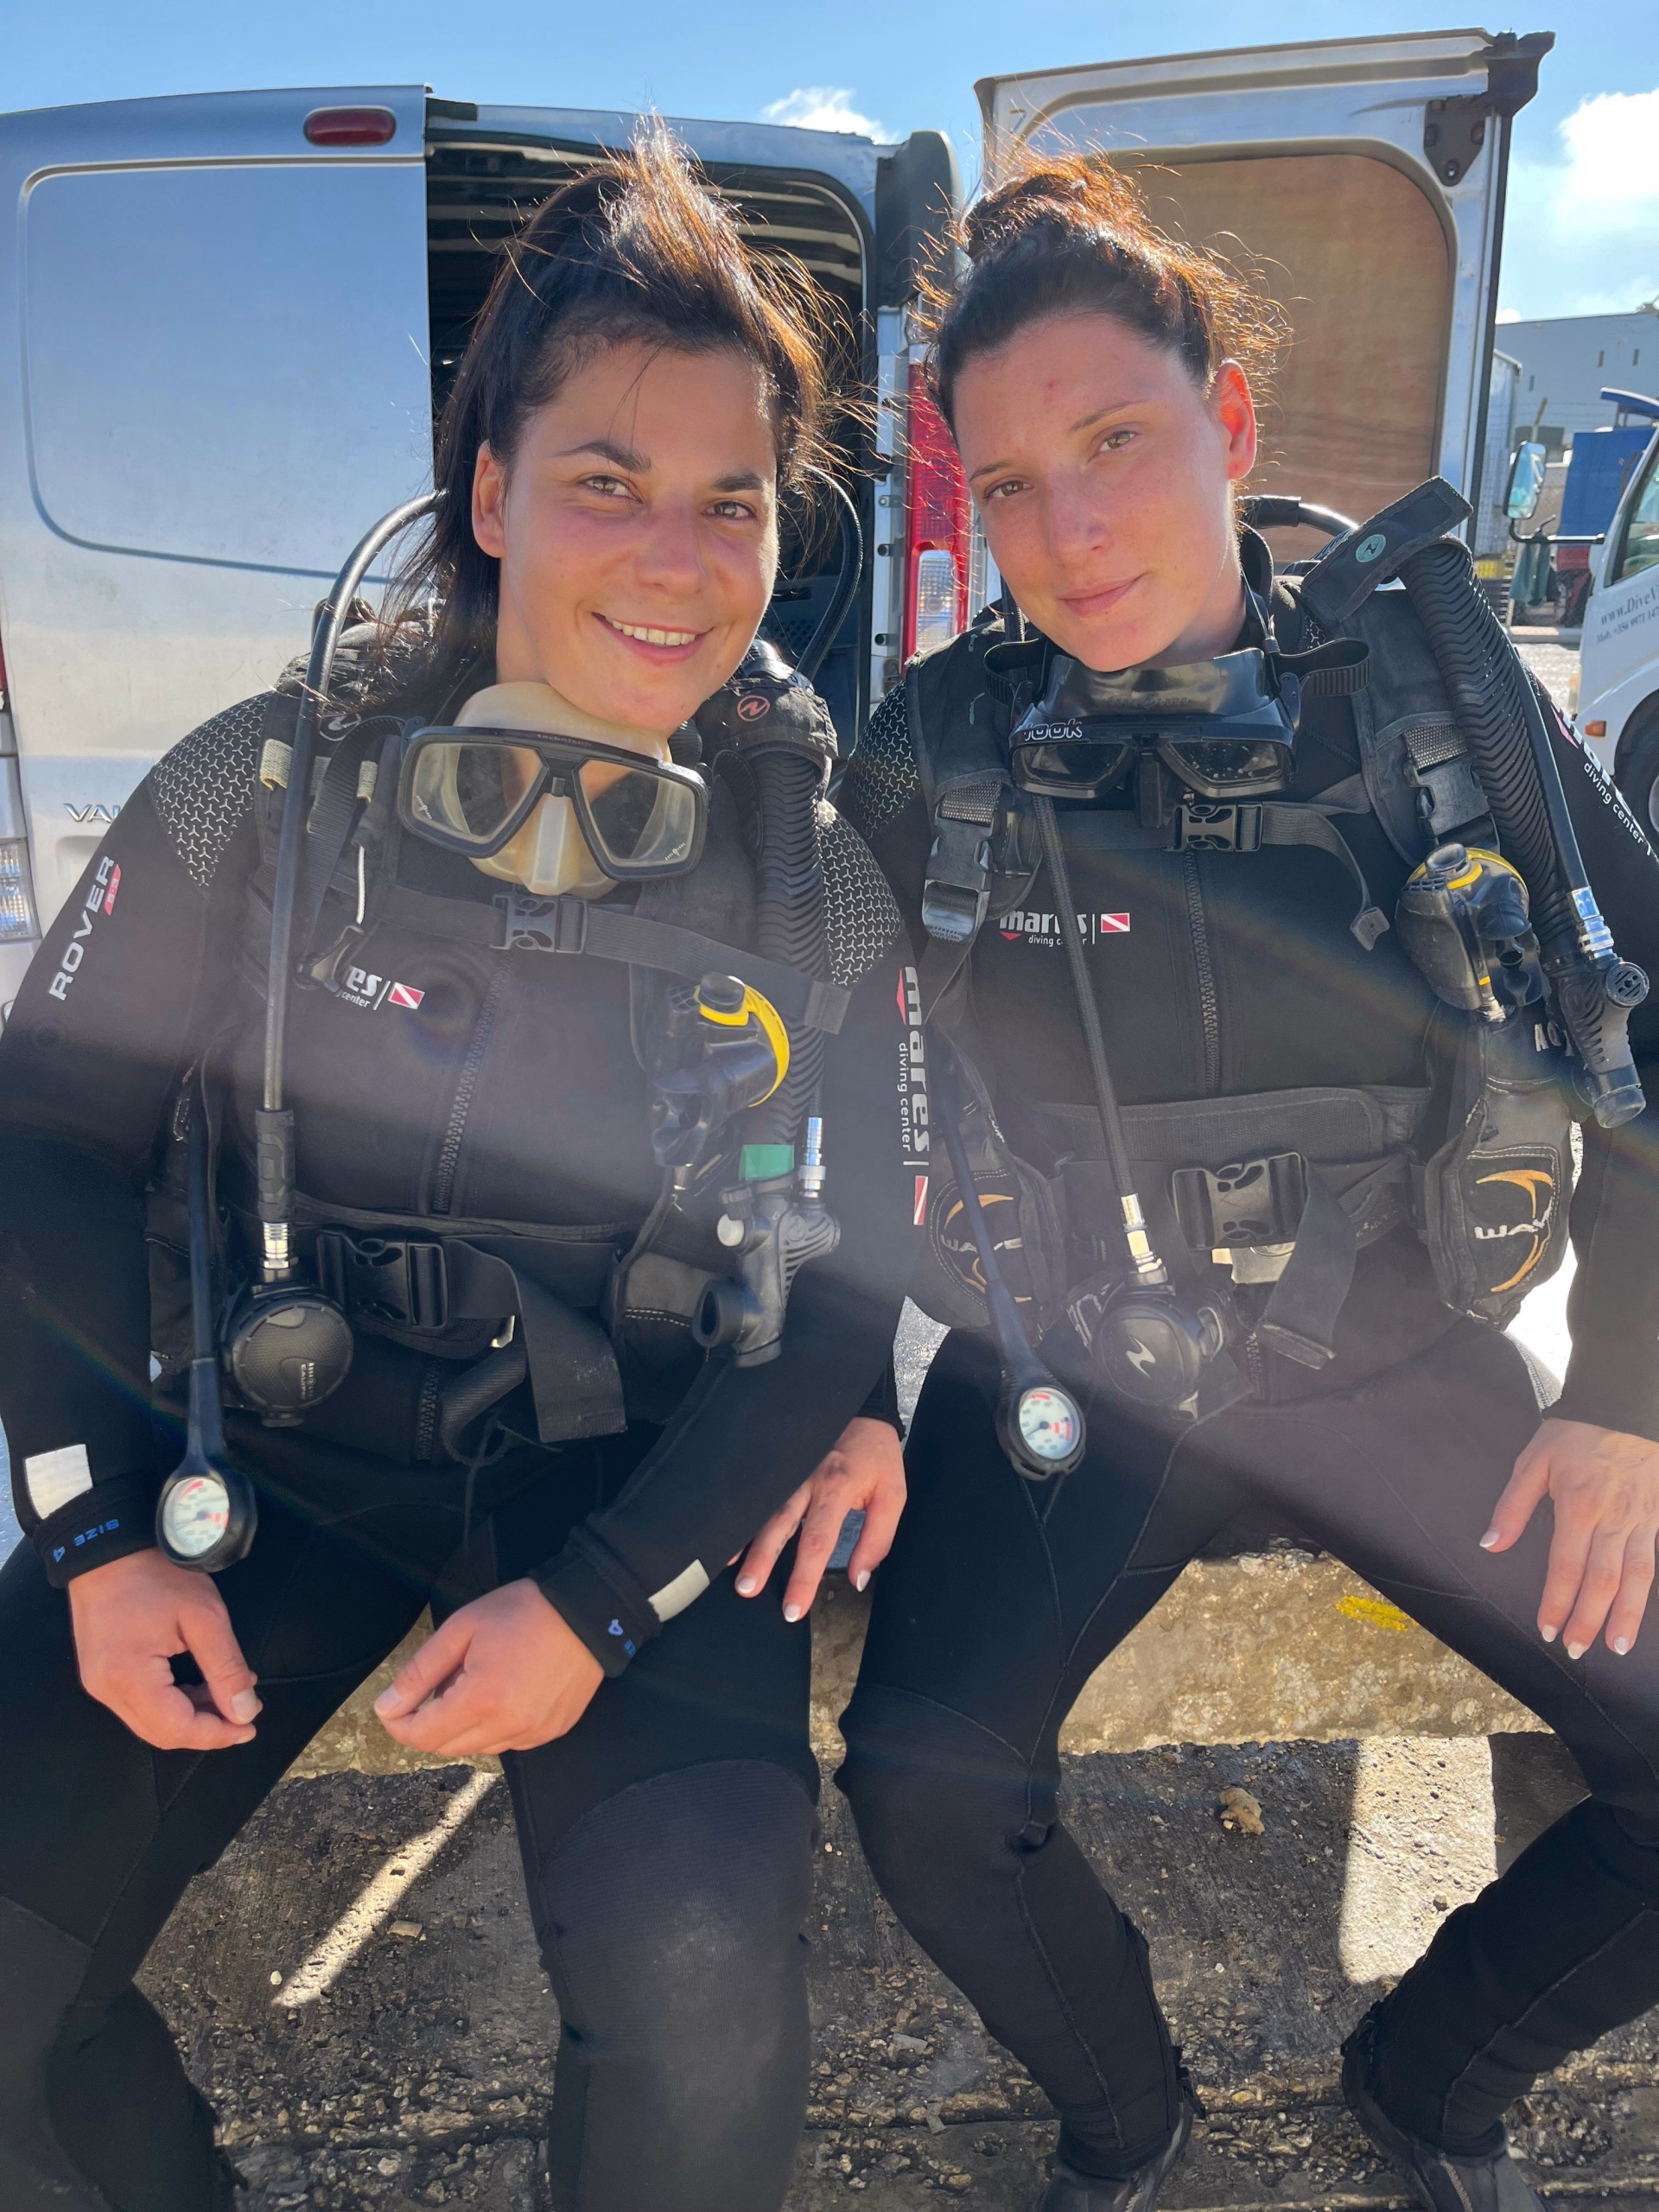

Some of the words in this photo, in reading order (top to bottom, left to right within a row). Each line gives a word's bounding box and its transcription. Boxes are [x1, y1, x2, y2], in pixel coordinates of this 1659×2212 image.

[1583, 762, 1612, 805] diving
[1612, 804, 1644, 844] center
[48, 855, 115, 1001] ROVER
[1028, 934, 1054, 948] diving
[341, 991, 372, 1008] center
[897, 1042, 909, 1092] diving
[905, 966, 930, 1152] mares
[899, 1097, 912, 1152] center
[53, 1546, 66, 1563] 4
[73, 1518, 119, 1547] SIZE
